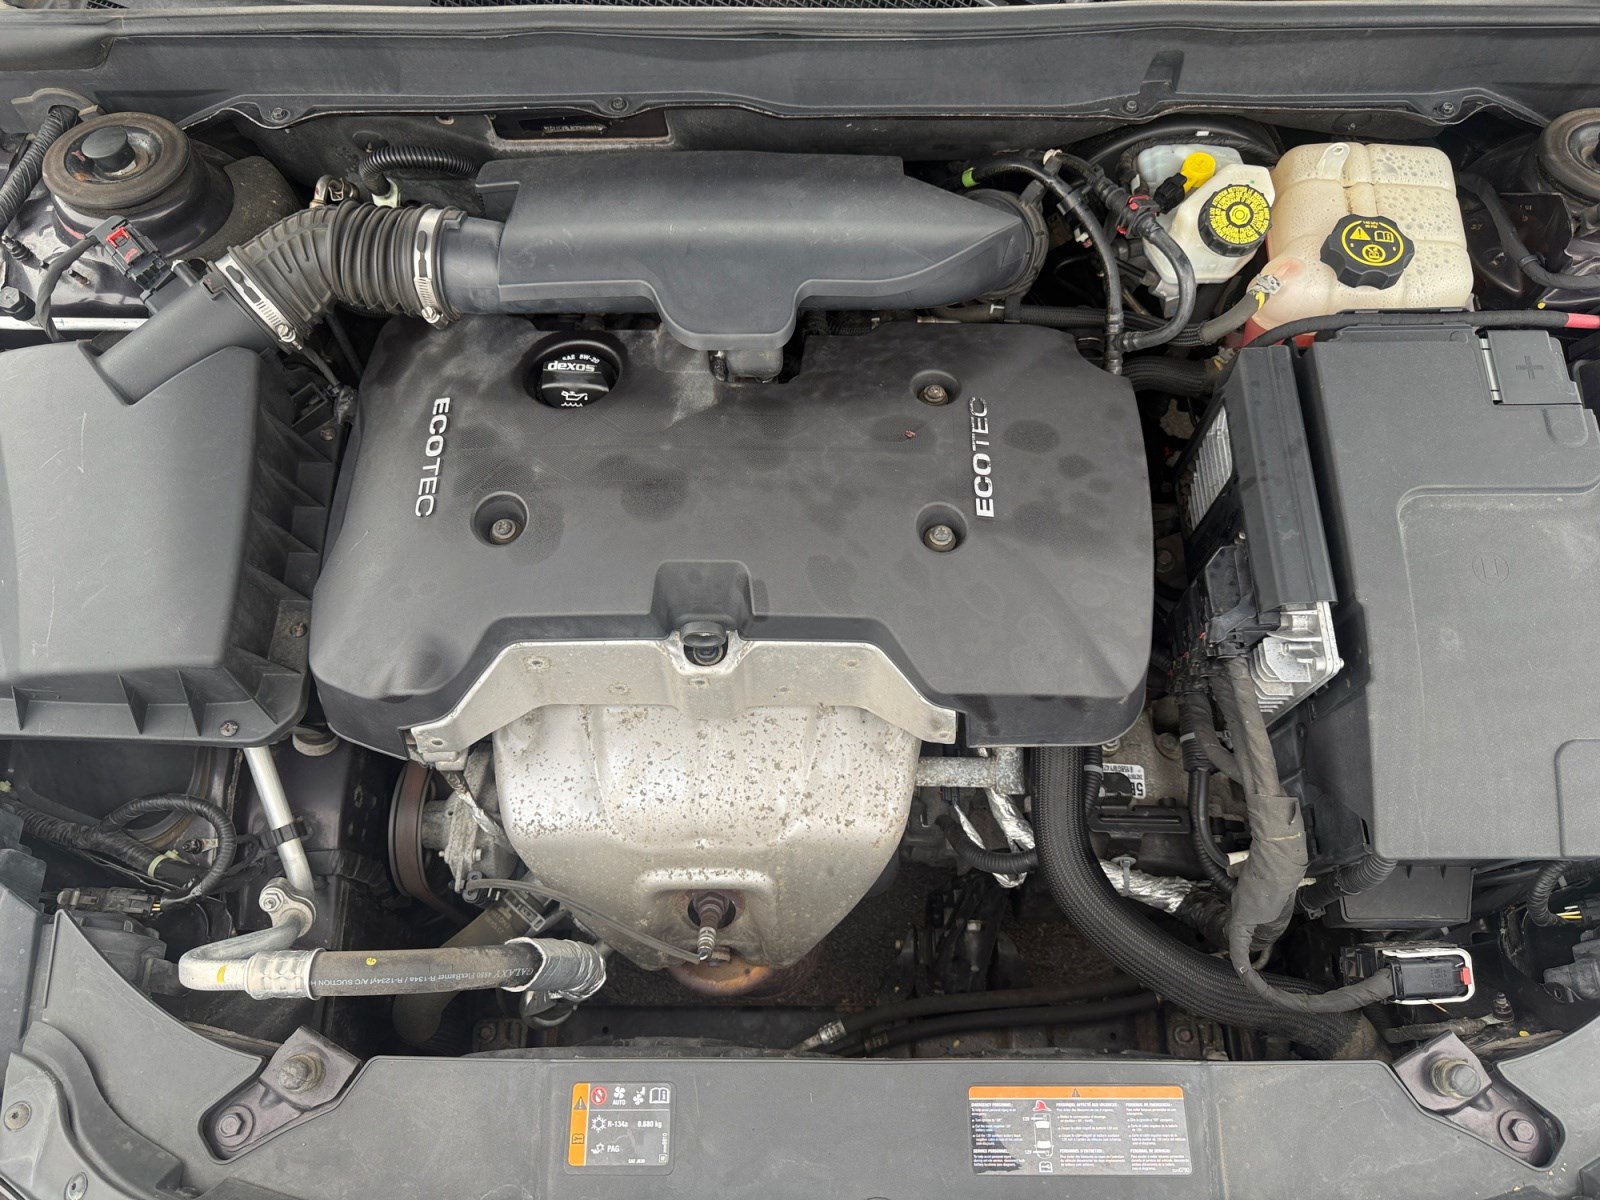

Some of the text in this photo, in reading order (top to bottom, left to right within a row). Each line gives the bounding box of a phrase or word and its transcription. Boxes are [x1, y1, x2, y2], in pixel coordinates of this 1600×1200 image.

[548, 361, 595, 372] dexos
[415, 397, 451, 517] ECOTEC
[969, 397, 995, 517] ECOTEC
[495, 967, 534, 978] GALAXY
[370, 977, 403, 985] R-1234yf
[607, 1120, 629, 1128] R-134a
[607, 1144, 620, 1153] PAG
